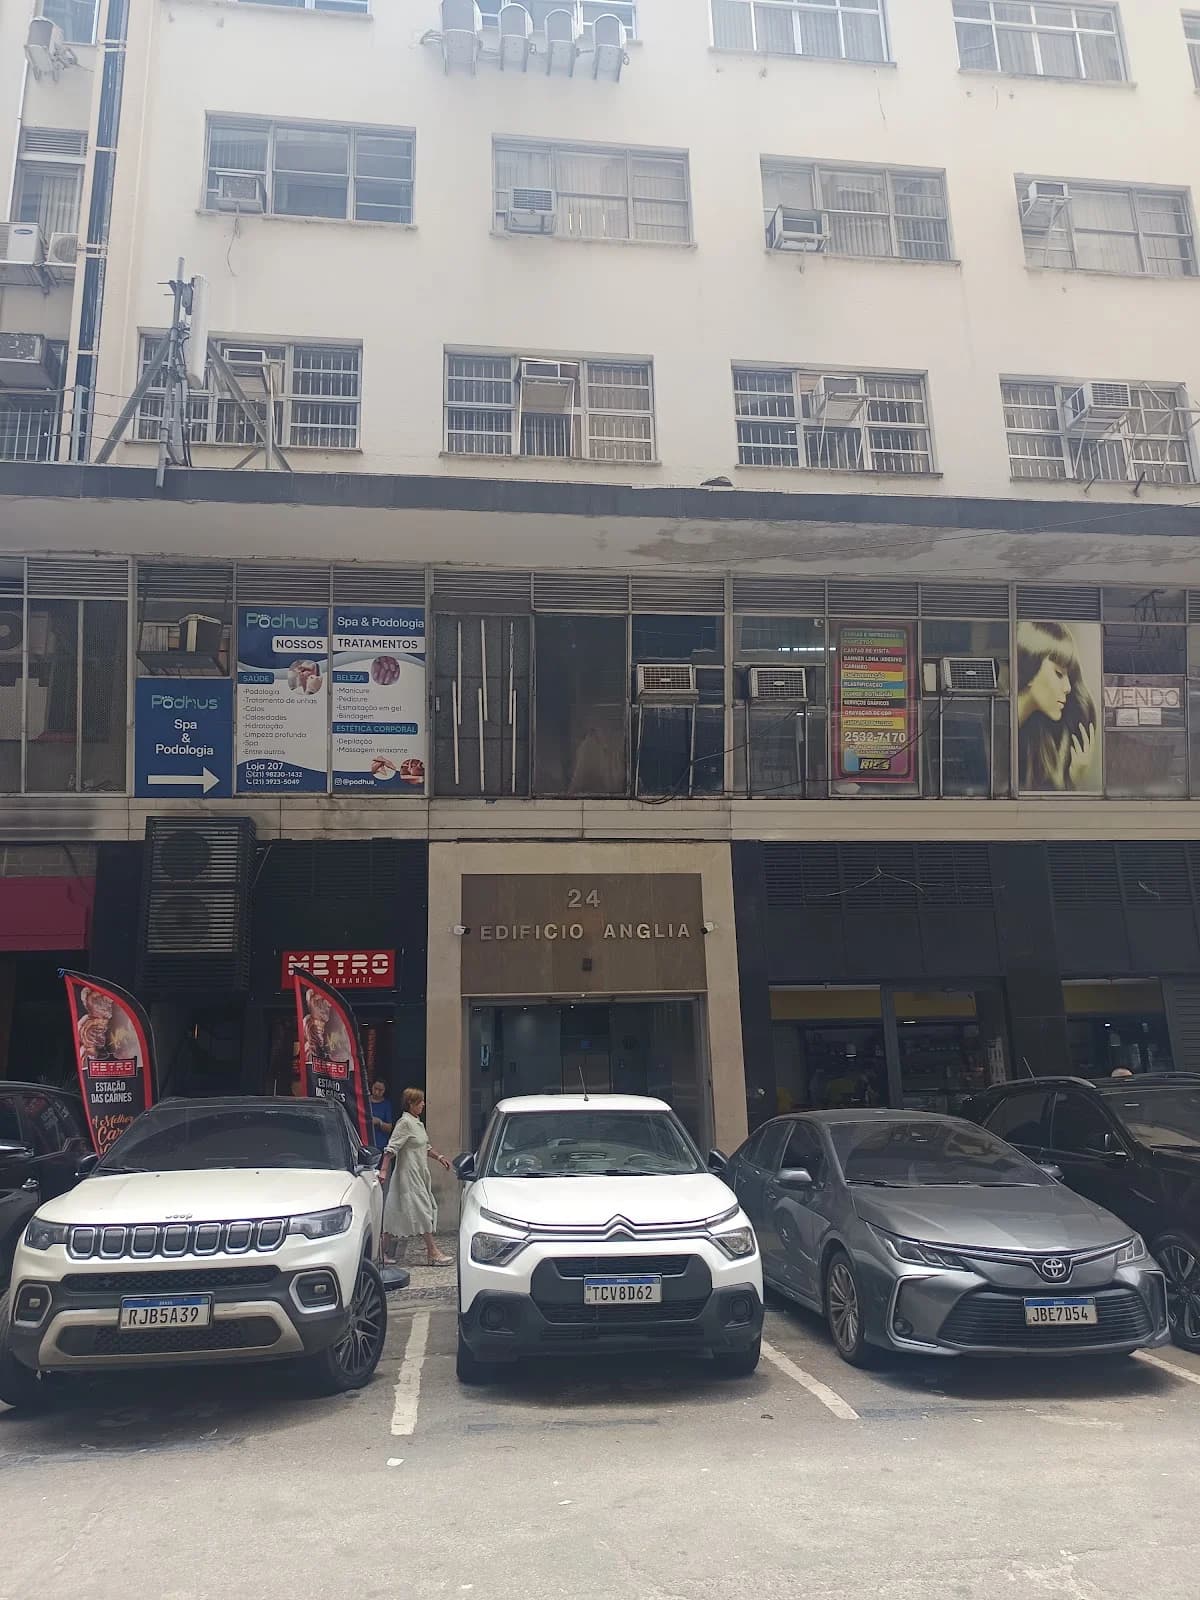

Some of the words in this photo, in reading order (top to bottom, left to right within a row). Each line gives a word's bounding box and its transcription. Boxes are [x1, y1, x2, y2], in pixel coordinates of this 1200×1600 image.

[337, 616, 358, 628] Spa
[361, 617, 369, 627] &
[371, 617, 424, 630] Podologia
[276, 639, 323, 649] NOSSOS
[337, 638, 418, 649] TRATAMENTOS
[243, 673, 270, 682] SAÚDE
[1103, 688, 1179, 707] VENDO
[174, 718, 198, 732] Spa
[181, 732, 191, 743] &
[844, 731, 906, 743] 2532-7170
[155, 743, 214, 758] Podologia
[246, 763, 265, 772] Loja
[567, 889, 600, 908] 24
[480, 924, 584, 940] EDIFICIO
[603, 923, 690, 939] ANGLIA
[288, 954, 389, 976] METRO
[91, 1062, 132, 1072] METRO
[95, 1080, 126, 1093] ESTAÇÃO
[91, 1093, 104, 1104] DAS
[104, 1093, 132, 1104] CARNES
[592, 1285, 653, 1301] TCV8D62
[128, 1307, 199, 1325] RJB5A39
[1032, 1306, 1088, 1322] JBE7D54
